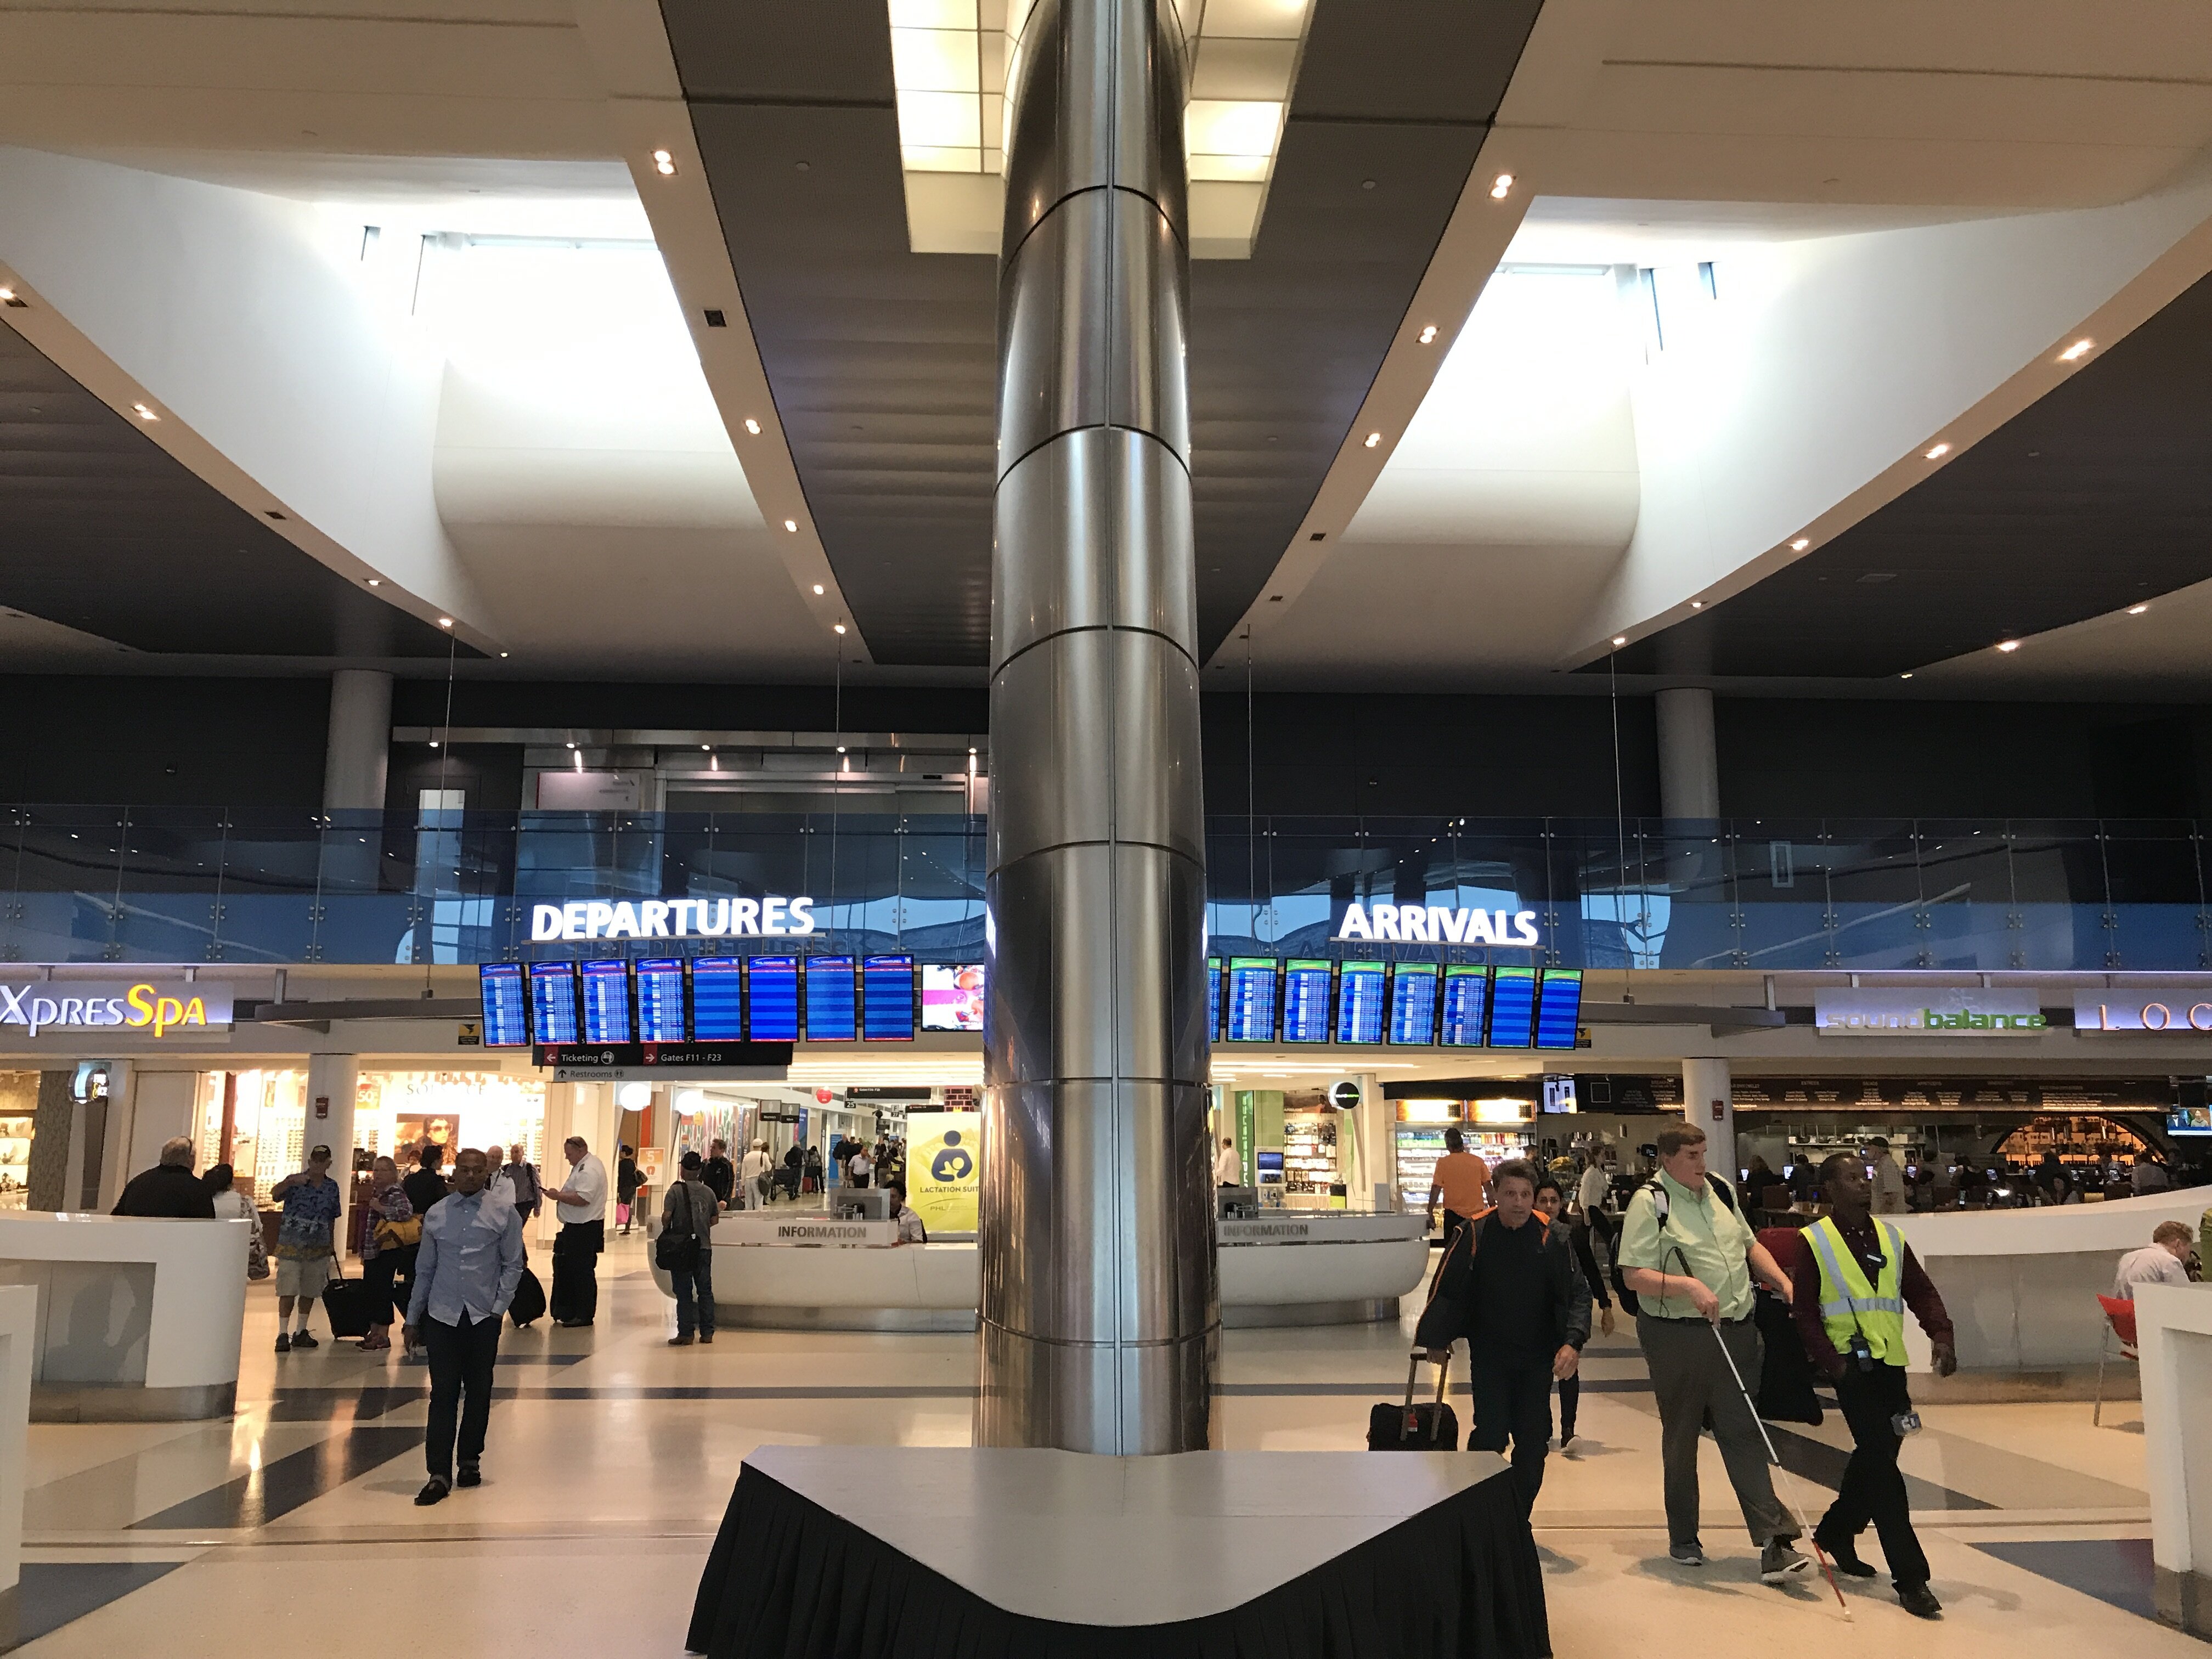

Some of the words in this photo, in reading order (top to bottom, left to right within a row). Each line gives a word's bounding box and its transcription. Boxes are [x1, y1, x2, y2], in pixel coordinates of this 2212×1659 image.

[531, 897, 815, 940] DEPARTURES
[1338, 903, 1538, 946] ARRIVALS
[1826, 1008, 2047, 1030] soundbalance
[561, 1054, 599, 1063] Ticketing
[406, 1084, 486, 1096] SOLCE
[778, 1226, 867, 1238] INFORMATION
[1224, 1224, 1308, 1236] INFORMATION
